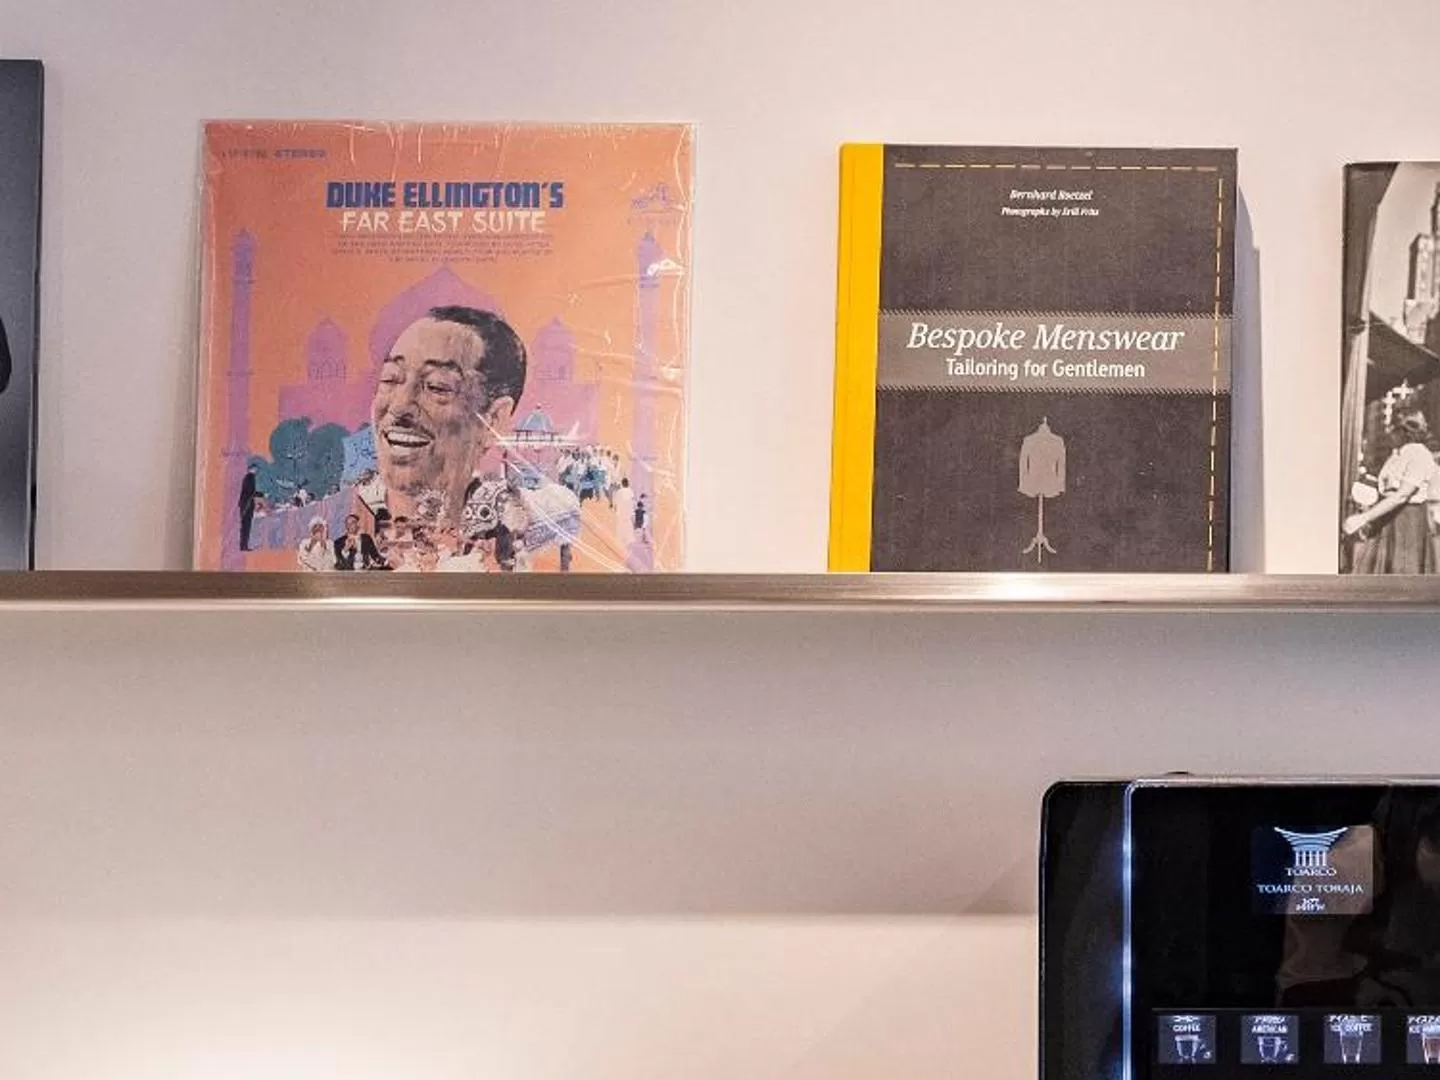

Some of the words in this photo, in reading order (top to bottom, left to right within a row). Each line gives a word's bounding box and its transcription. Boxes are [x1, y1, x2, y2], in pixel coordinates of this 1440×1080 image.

[326, 181, 396, 209] DUKE
[403, 181, 565, 209] ELLINGTON'S
[341, 211, 389, 233] FAR
[400, 211, 464, 233] EAST
[472, 211, 546, 233] SUITE
[907, 322, 1025, 356] Bespoke
[1033, 323, 1185, 351] Menswear
[946, 359, 1018, 380] Tailoring
[1024, 359, 1048, 377] for
[1052, 359, 1145, 378] Gentlemen
[1285, 867, 1338, 877] TOARCO
[1256, 883, 1312, 895] TOARCO
[1315, 883, 1364, 895] TORAJA
